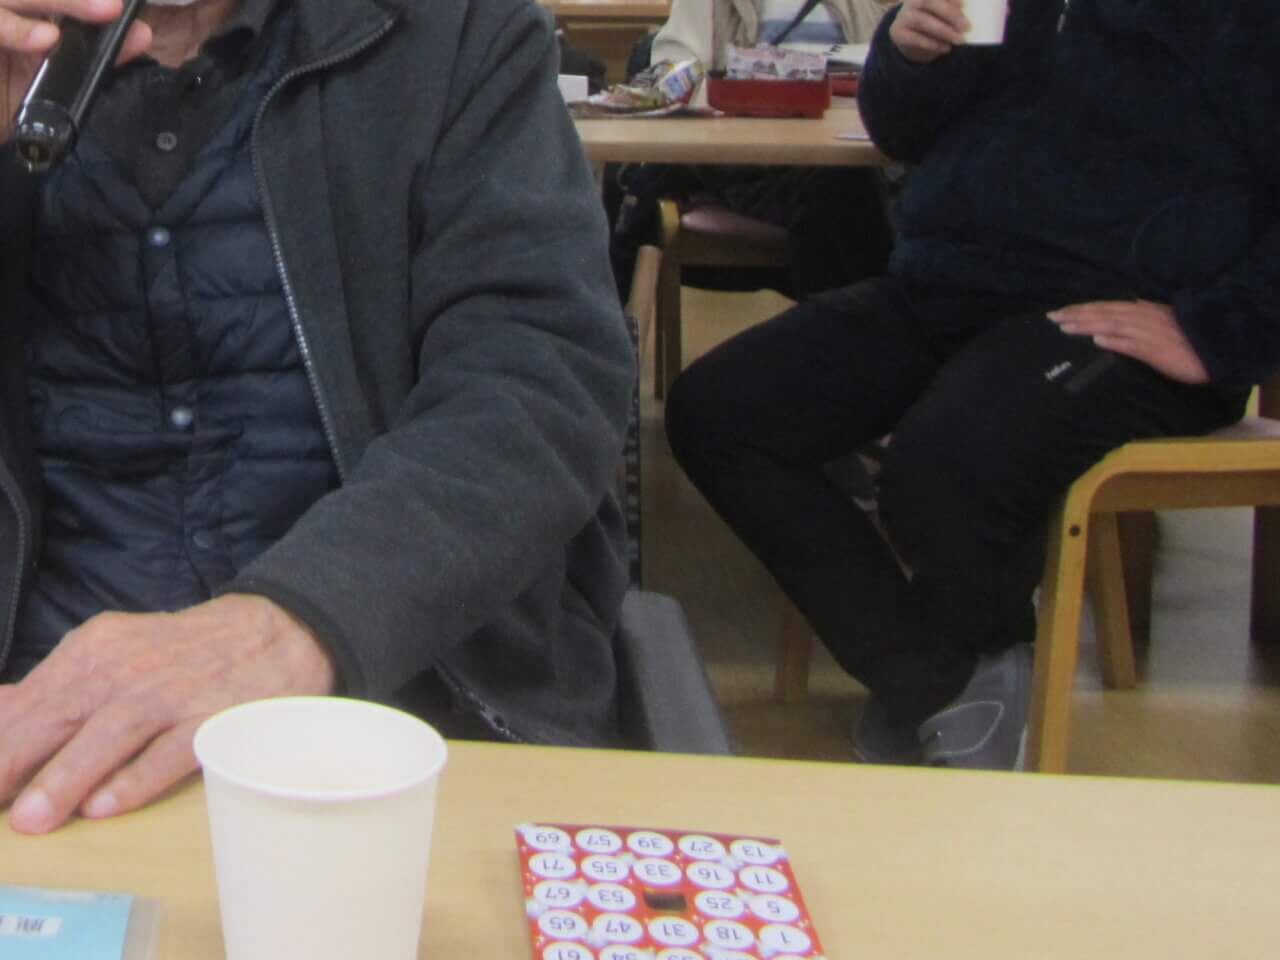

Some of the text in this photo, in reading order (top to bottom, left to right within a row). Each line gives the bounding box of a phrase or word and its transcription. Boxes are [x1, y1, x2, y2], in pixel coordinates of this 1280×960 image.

[535, 832, 765, 858] 69 57 39 27 13
[543, 858, 775, 885] 71 55 33 16 11
[545, 887, 781, 914] 67 53 25 5
[549, 916, 791, 944] 65 47 31 18 1
[557, 948, 581, 960] 61
